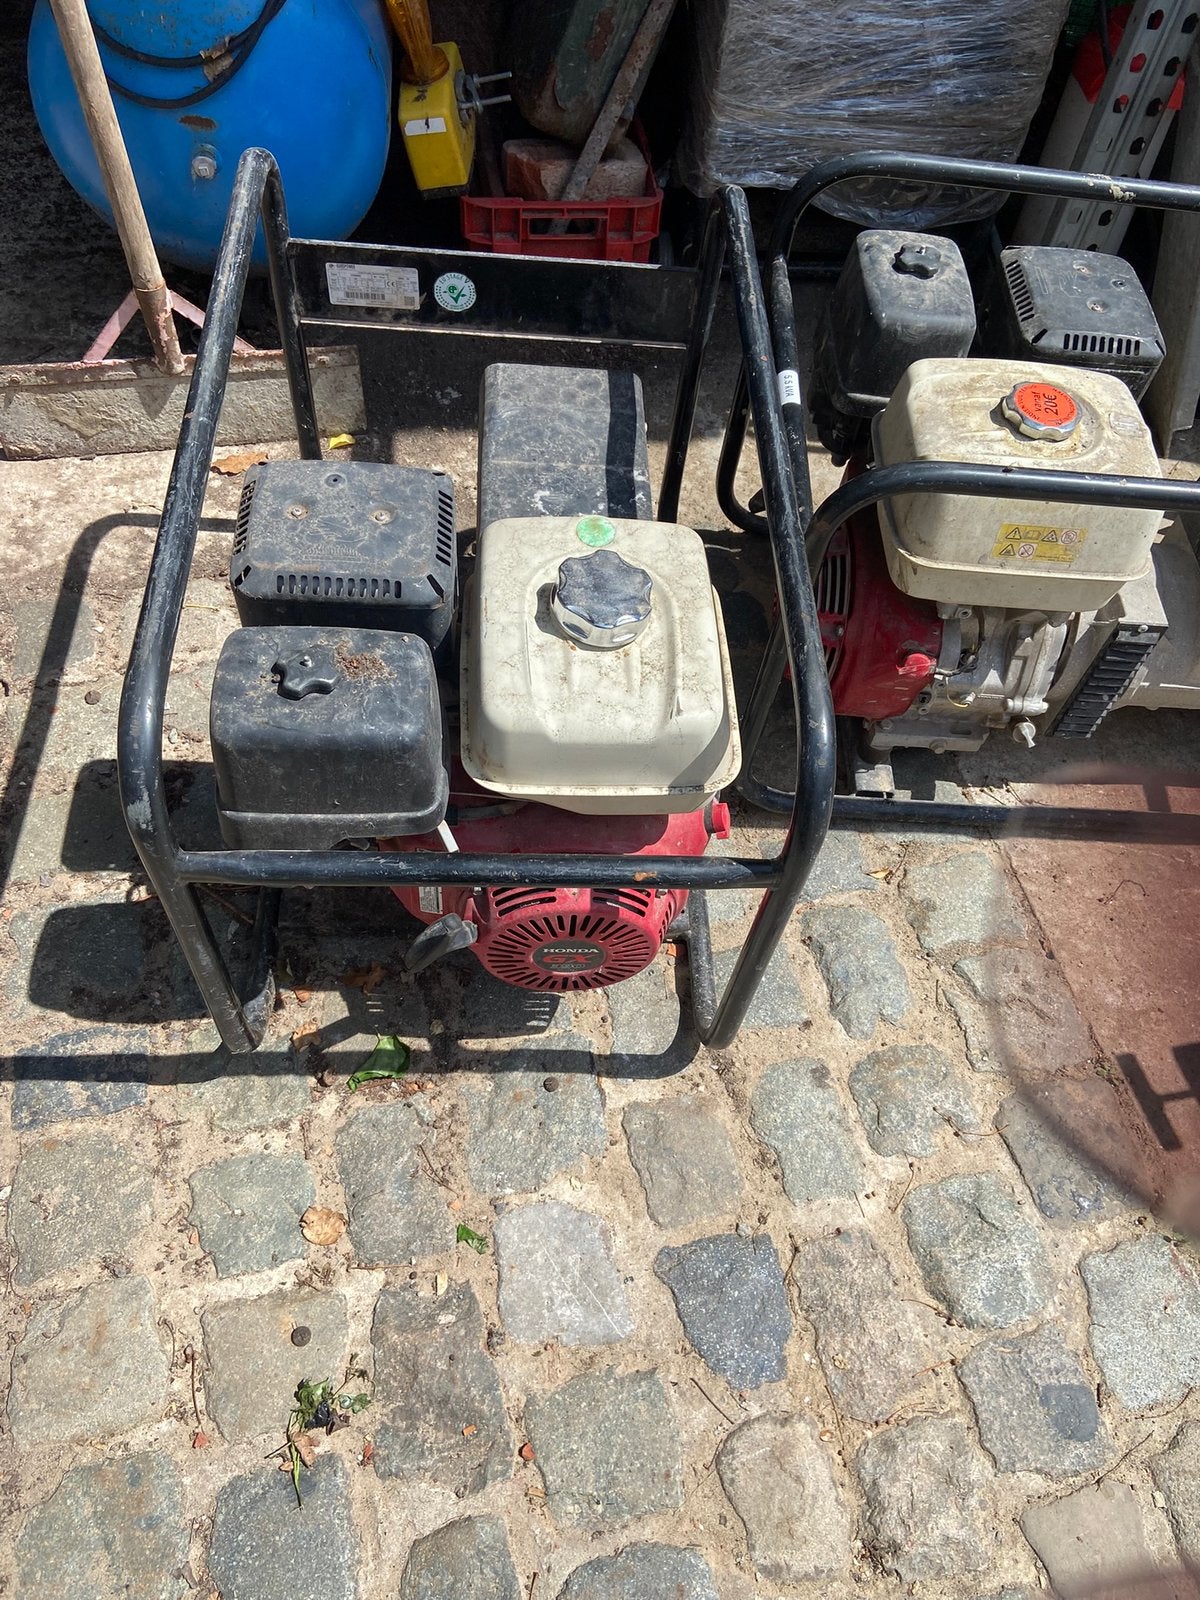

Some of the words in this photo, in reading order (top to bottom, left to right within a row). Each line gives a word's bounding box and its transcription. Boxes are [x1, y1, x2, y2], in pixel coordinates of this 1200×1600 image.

[1031, 390, 1042, 412] vanaf
[1043, 394, 1058, 416] 20€
[543, 954, 597, 964] GX
